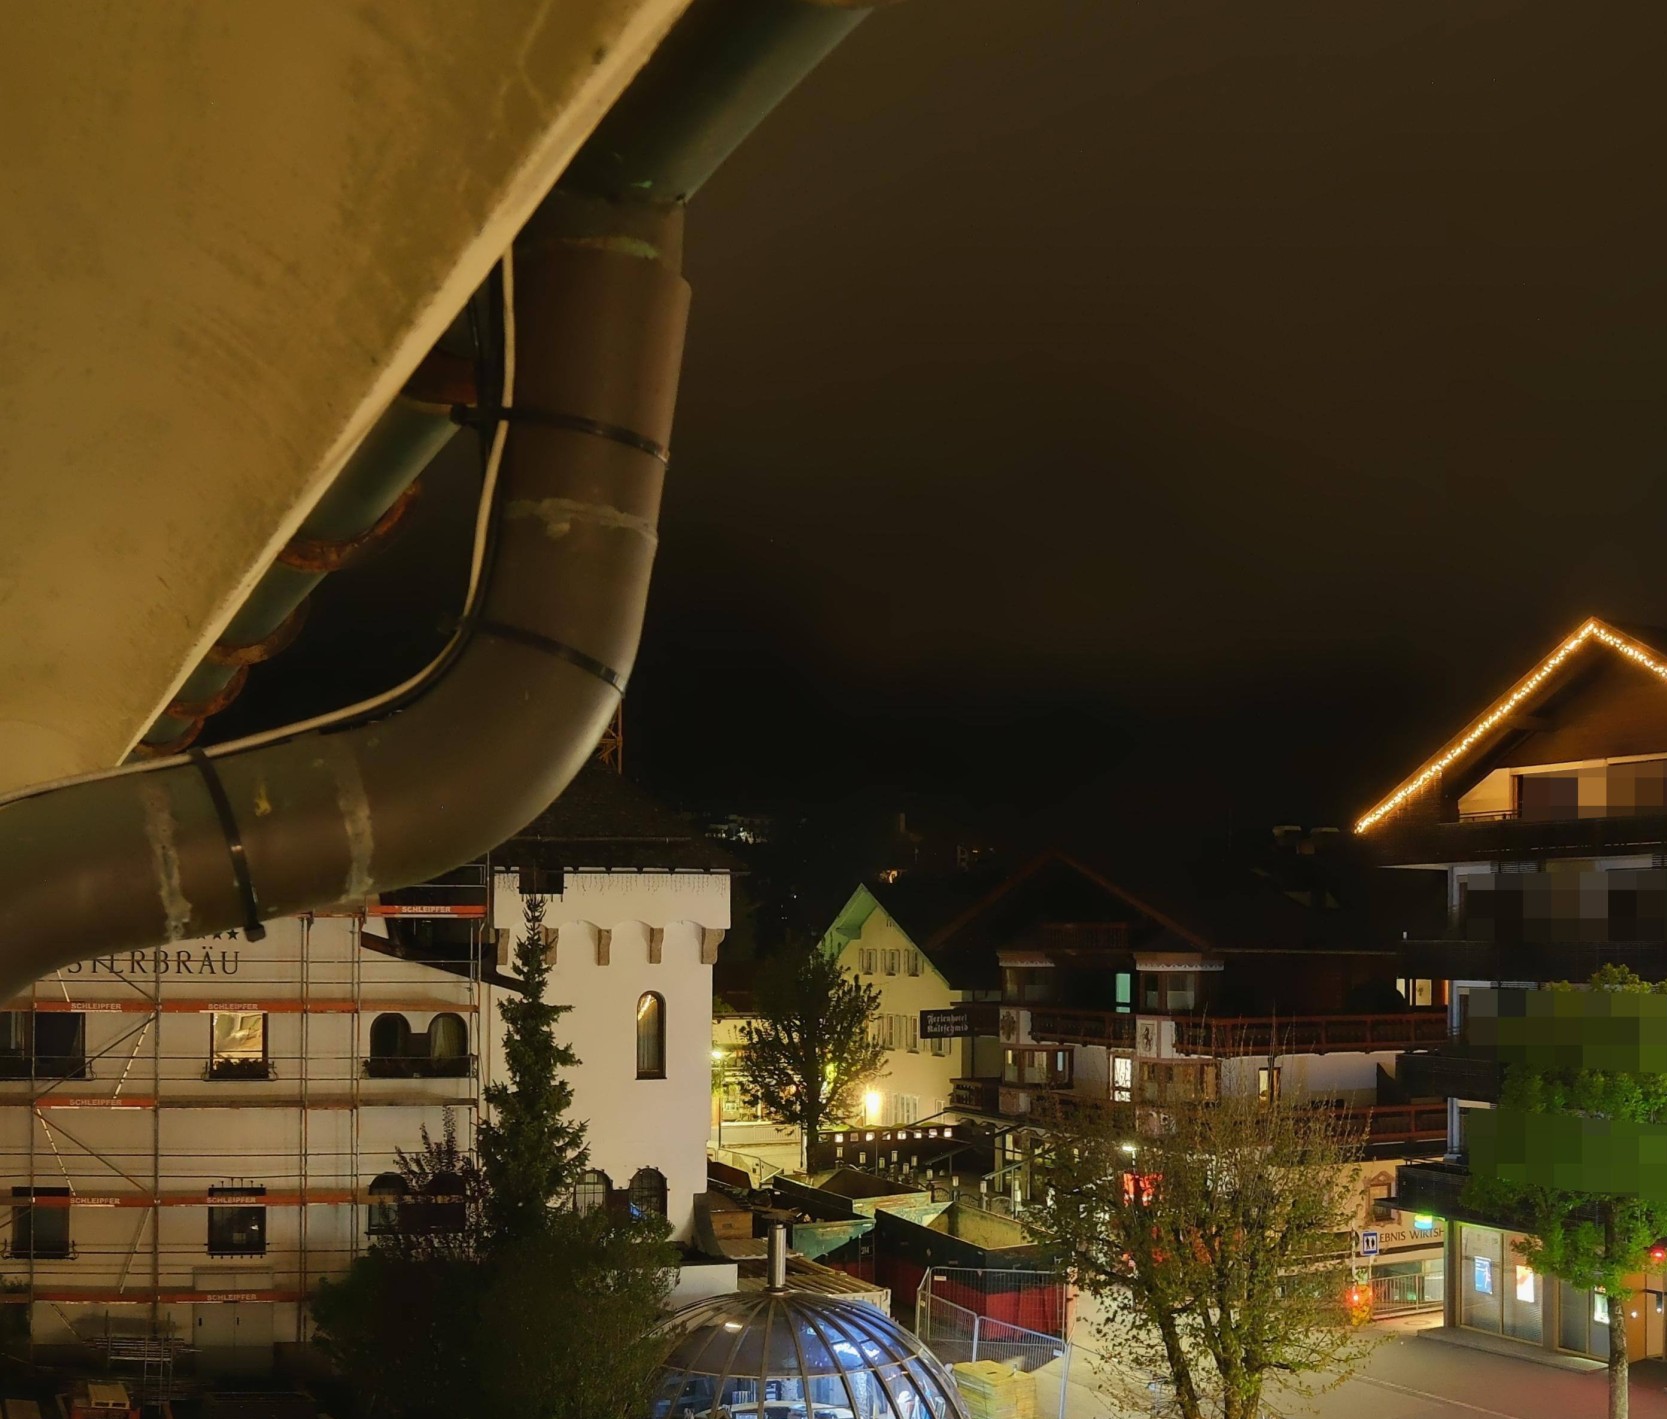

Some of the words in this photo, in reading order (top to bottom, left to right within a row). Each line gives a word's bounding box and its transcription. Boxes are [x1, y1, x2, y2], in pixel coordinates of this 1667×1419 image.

[401, 905, 452, 914] SCHLEIPFER
[71, 1002, 122, 1011] SCHLEIPFER
[207, 1002, 259, 1011] SCHLEIPFER
[69, 1098, 122, 1107] SCHLEIPFER
[70, 1196, 121, 1205] SCHLEIPFER
[206, 1196, 257, 1205] SCHLEIPFER
[1379, 1230, 1406, 1242] EBNIS
[206, 1292, 258, 1302] SCHLEIPFER
